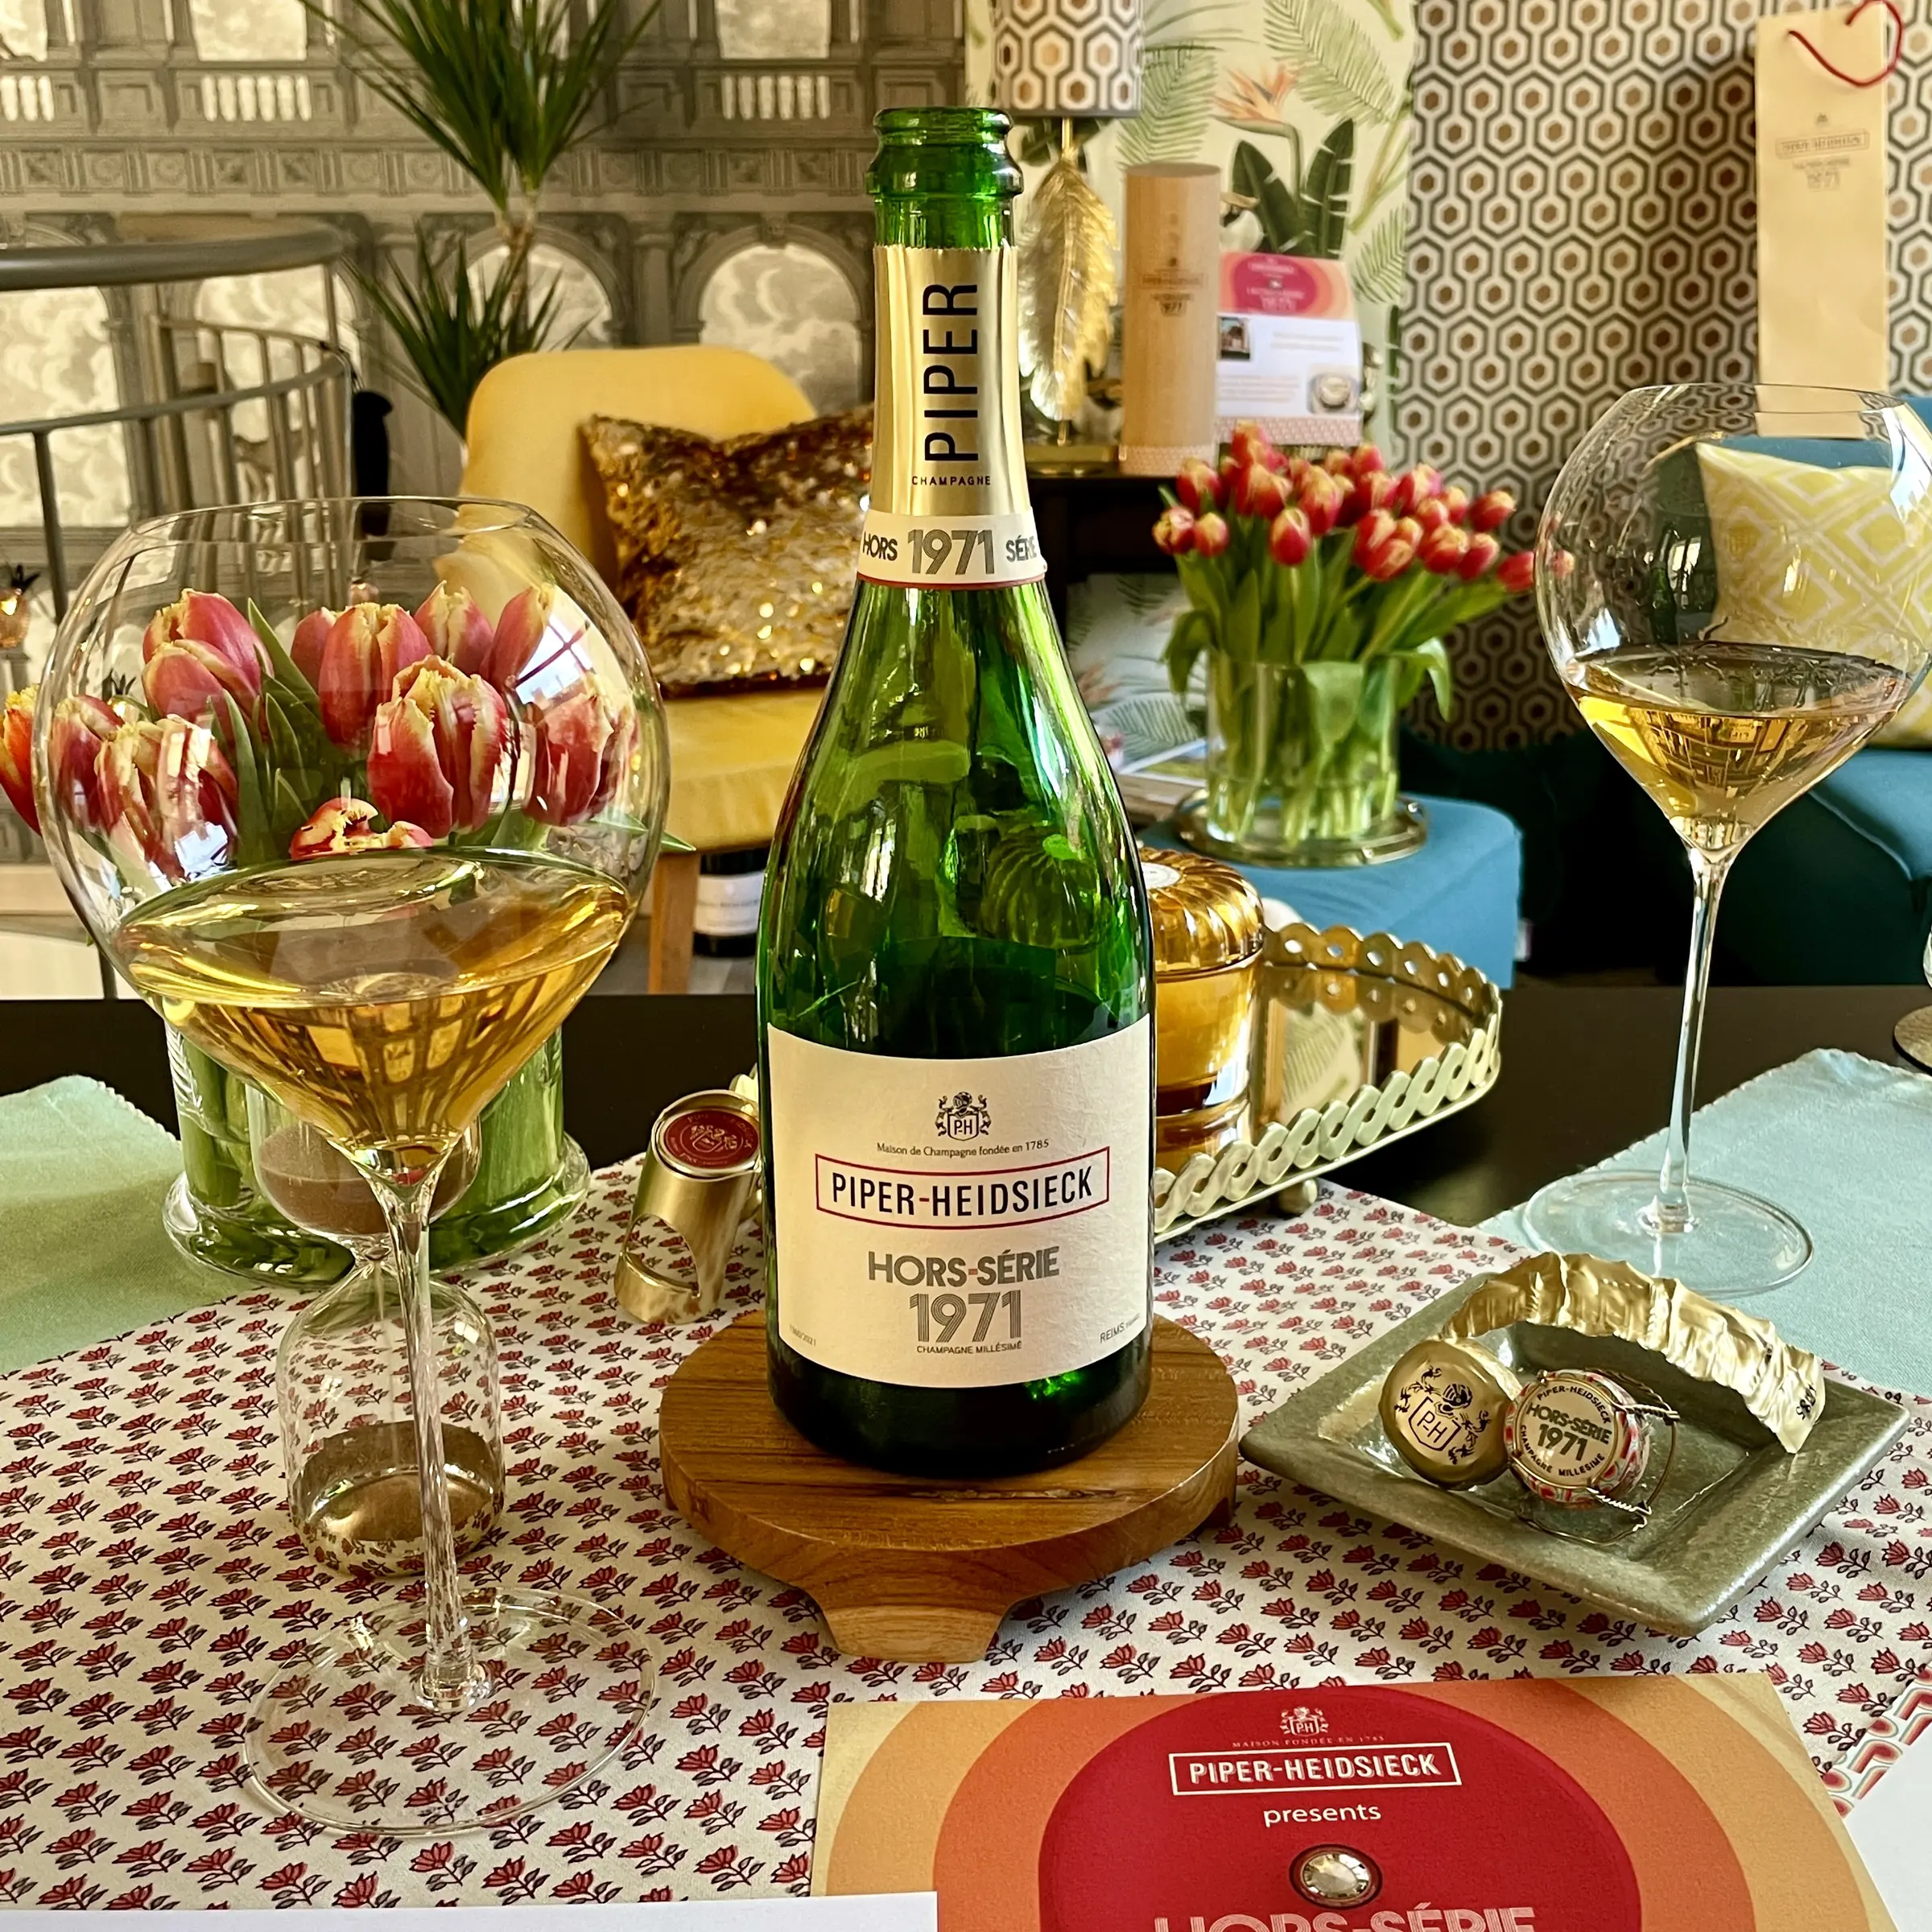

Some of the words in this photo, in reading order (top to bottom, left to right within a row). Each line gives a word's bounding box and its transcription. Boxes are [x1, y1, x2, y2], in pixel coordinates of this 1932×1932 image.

[923, 283, 978, 461] PIPER
[911, 475, 992, 486] CHAMPAGNE
[863, 531, 898, 561] HORS
[908, 529, 995, 575] 1971
[877, 1141, 907, 1155] Maison
[910, 1145, 921, 1154] de
[923, 1146, 976, 1159] Champagne
[979, 1144, 1009, 1155] fondée
[1025, 1139, 1049, 1150] 1785
[832, 1166, 1092, 1217] PIPER-HEIDSIECK
[869, 1245, 1059, 1287] HORS-SÉRIE
[910, 1290, 1022, 1342] 1971
[916, 1344, 973, 1355] CHAMPAGNE
[1525, 1402, 1612, 1445] HORS-SÉRIE
[1537, 1385, 1612, 1424] PIPER-HEIDSIECK
[1520, 1425, 1554, 1473] CHAMPAGNE
[1538, 1423, 1587, 1461] 1971
[1232, 1740, 1280, 1748] MAISON
[1188, 1752, 1443, 1785] PIPER-HEIDSIECK
[1262, 1801, 1382, 1828] presents
